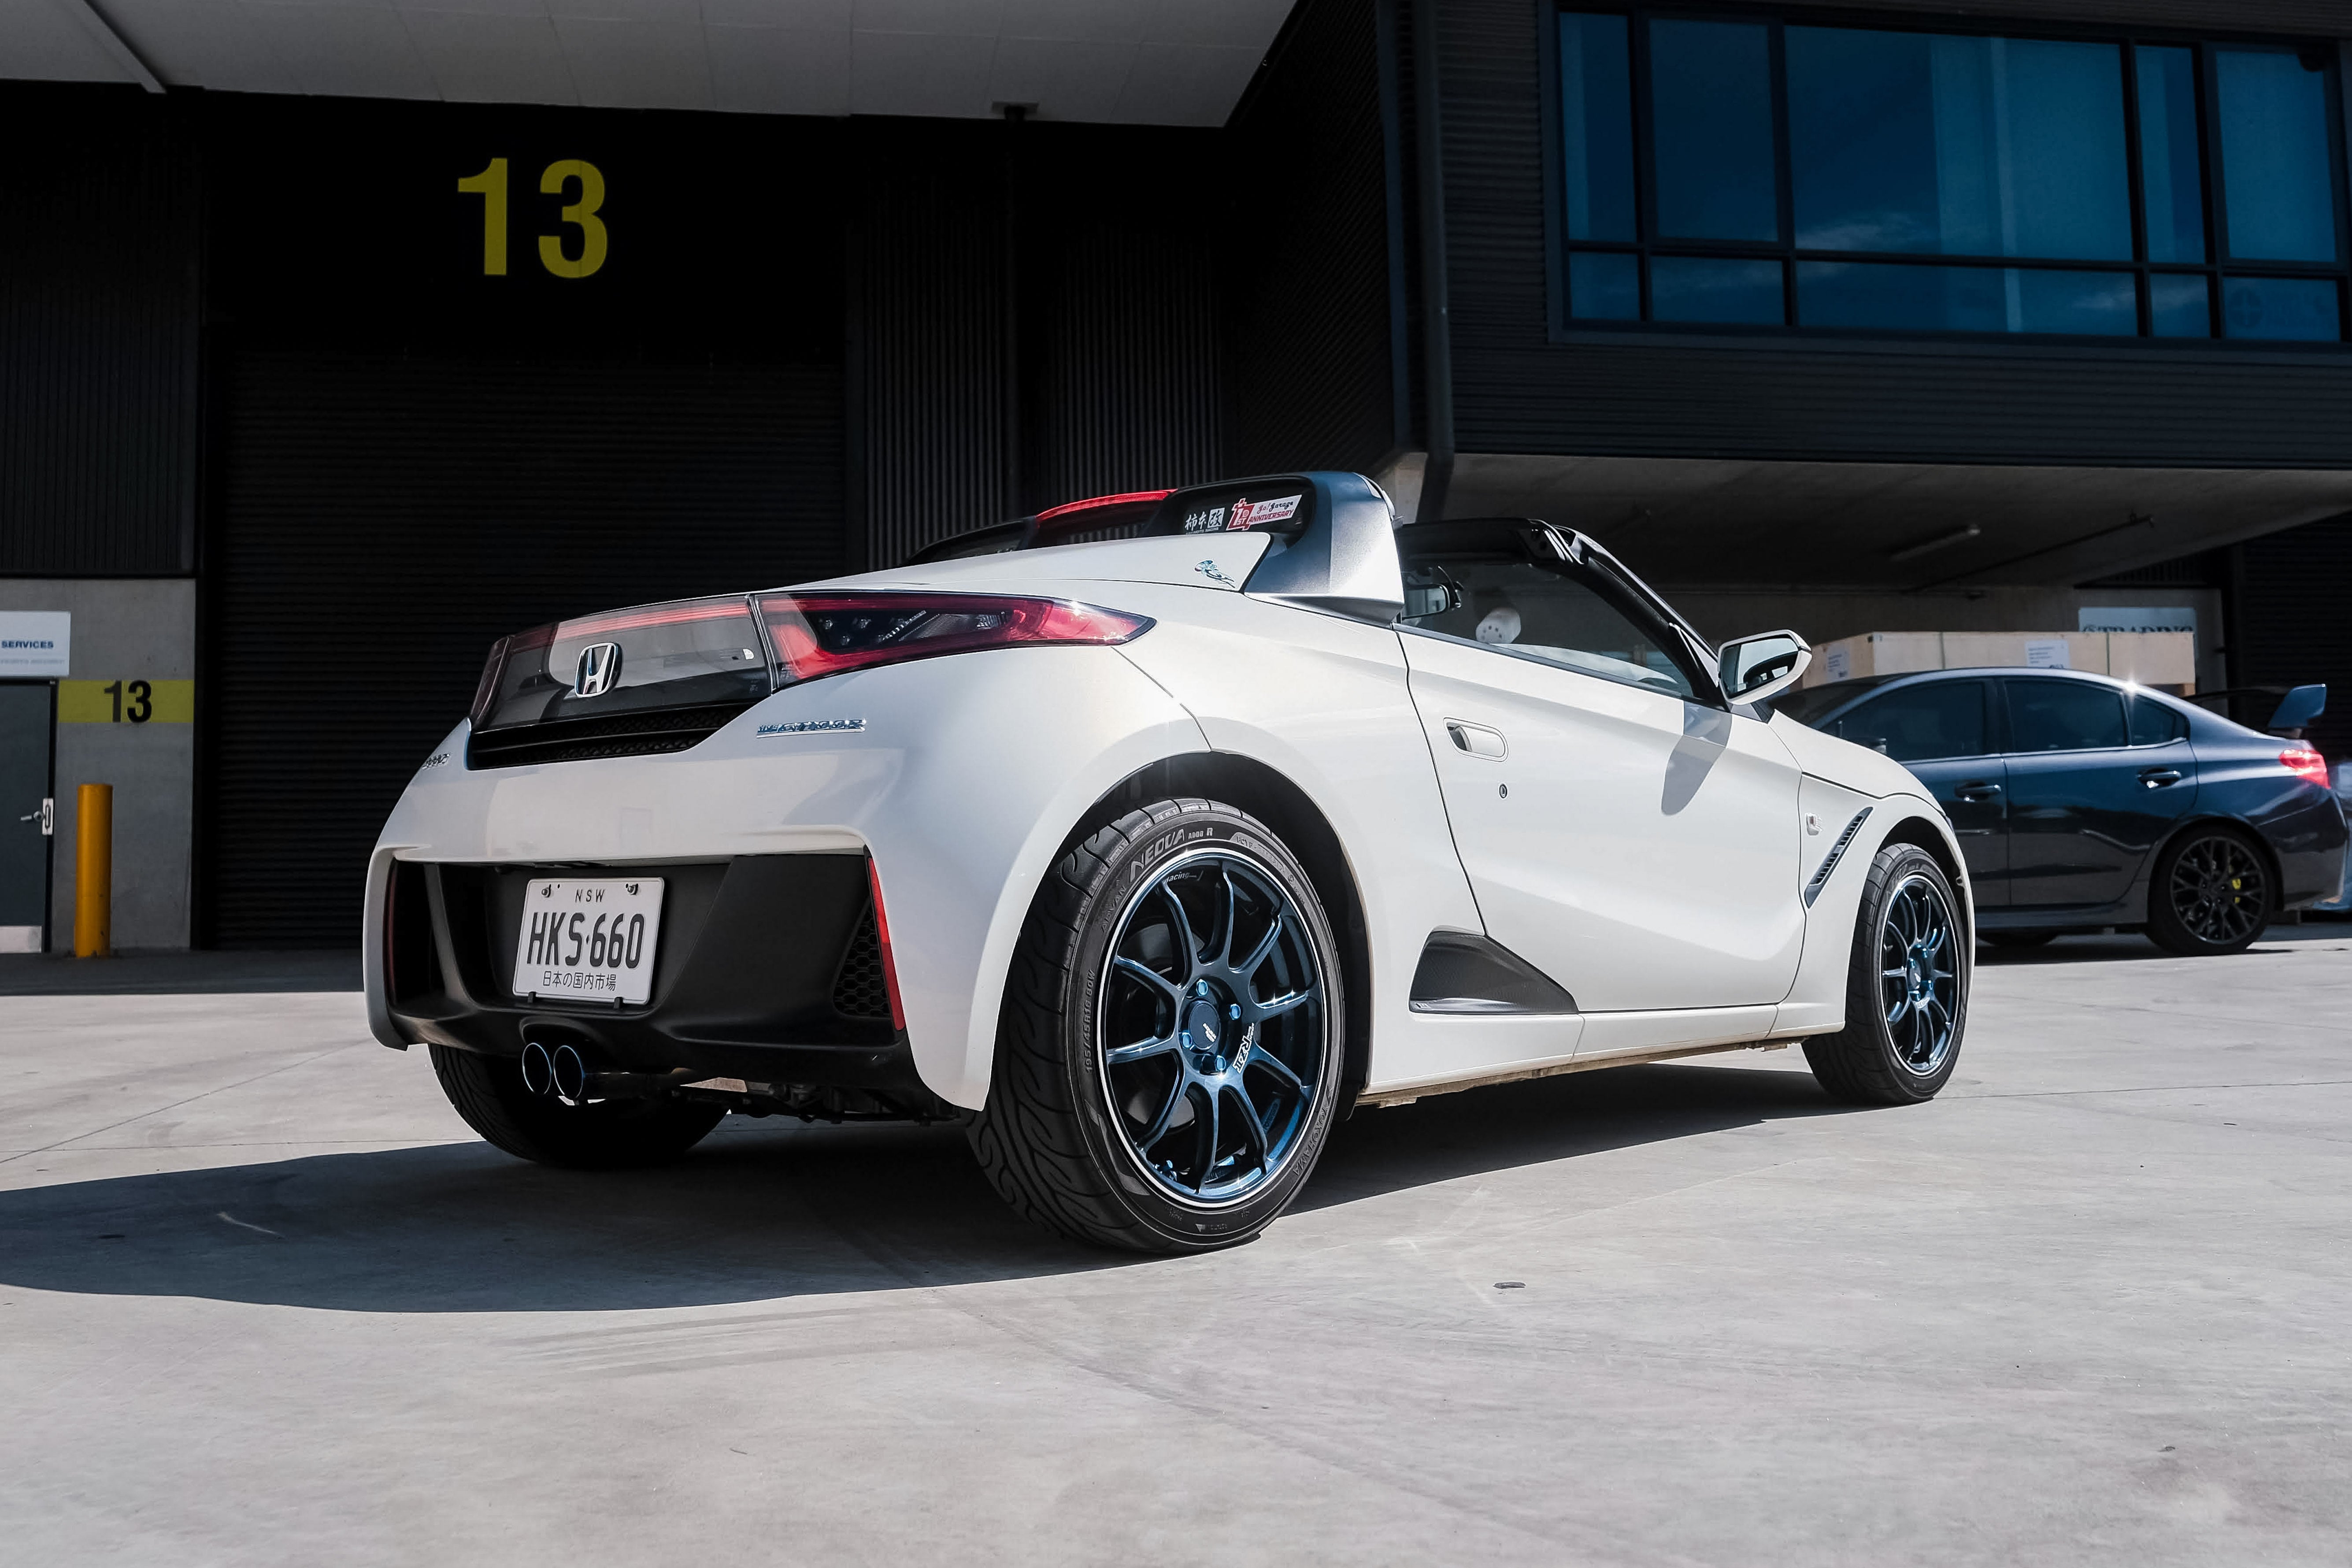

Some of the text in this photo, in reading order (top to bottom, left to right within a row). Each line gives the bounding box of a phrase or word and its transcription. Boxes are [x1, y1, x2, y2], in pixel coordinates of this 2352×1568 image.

[457, 157, 607, 278] 13
[1248, 509, 1294, 523] ANNIVERSARY
[104, 680, 152, 723] 13
[575, 889, 605, 903] NSW
[543, 971, 617, 991] 日本の国内市場
